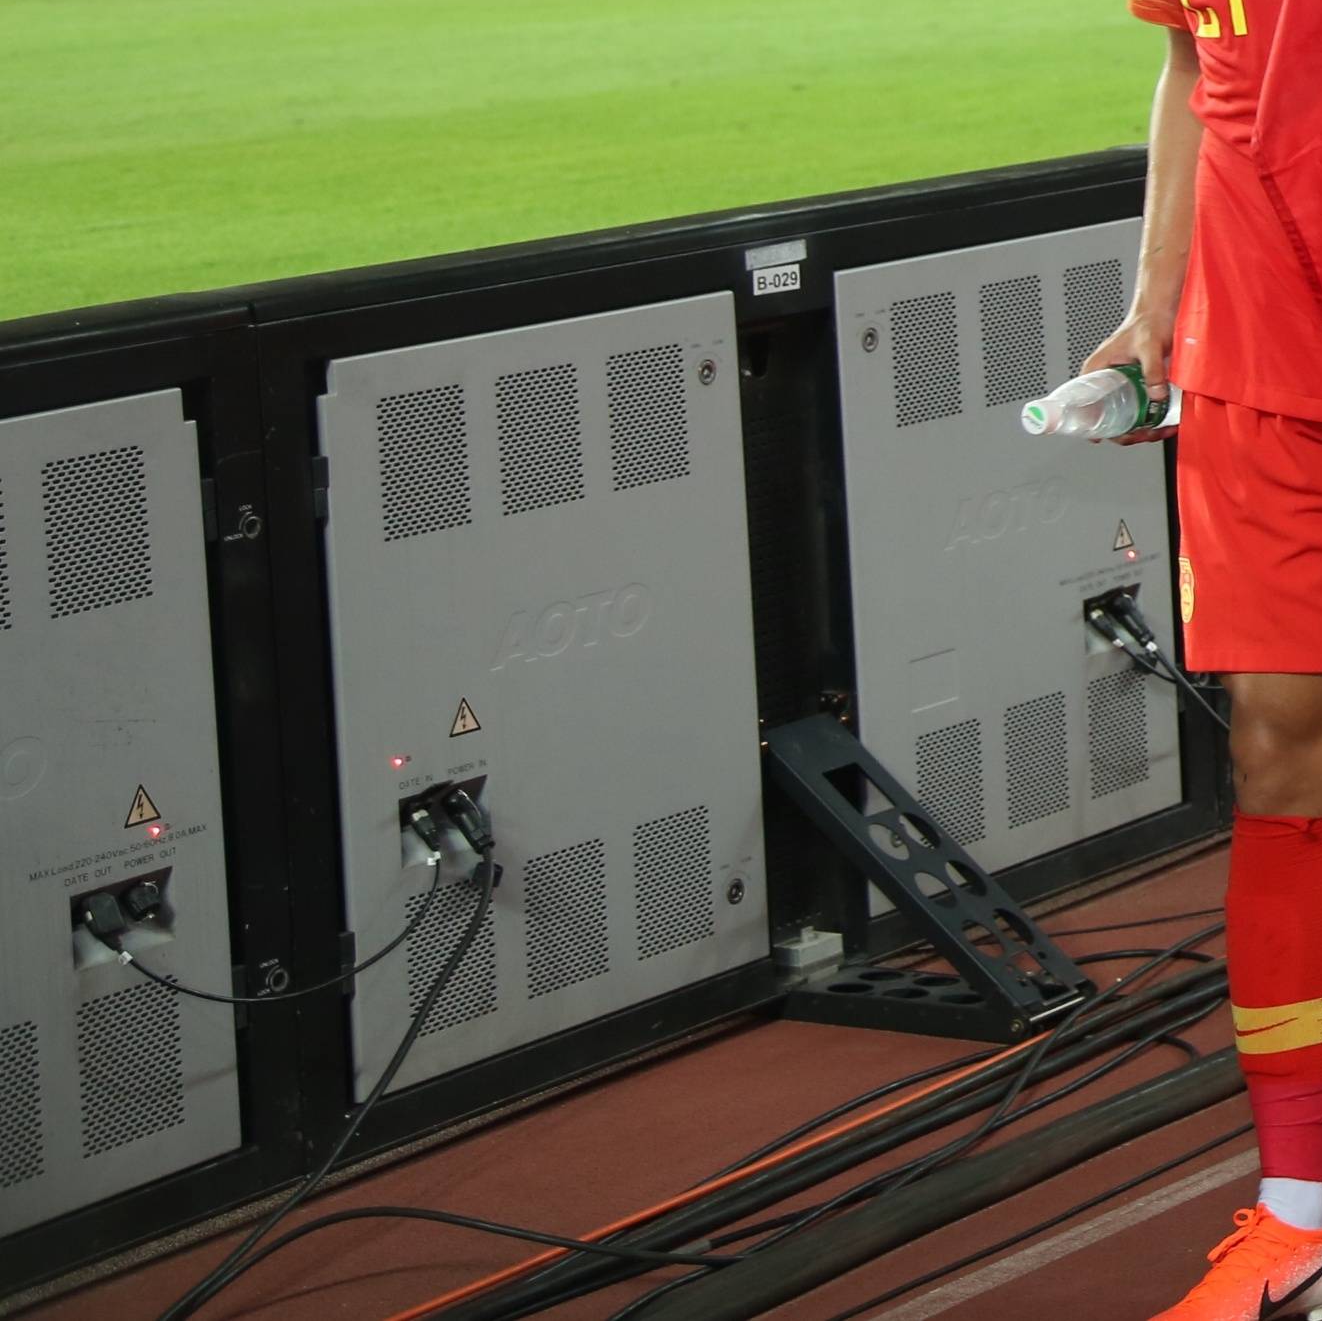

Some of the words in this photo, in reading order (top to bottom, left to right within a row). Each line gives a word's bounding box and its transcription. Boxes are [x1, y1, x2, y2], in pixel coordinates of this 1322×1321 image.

[757, 271, 798, 291] B-029
[488, 582, 651, 672] AOTO
[124, 854, 155, 869] POWER
